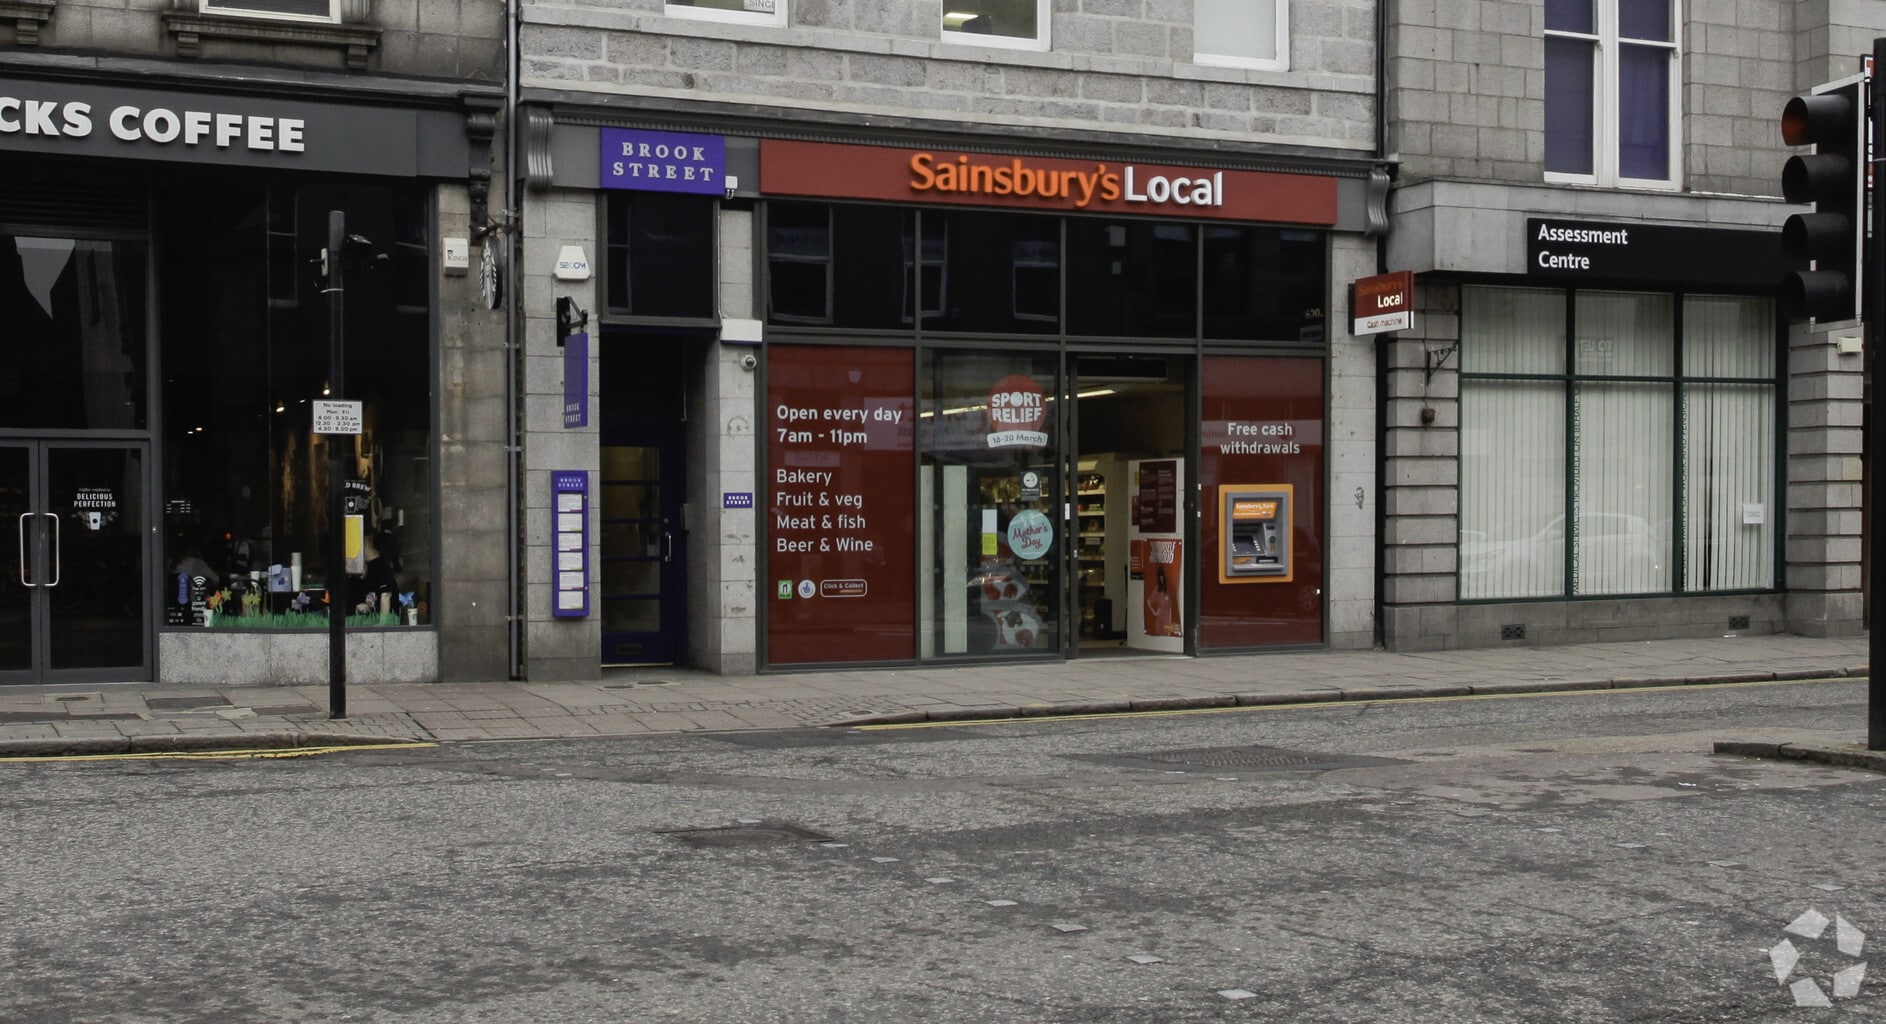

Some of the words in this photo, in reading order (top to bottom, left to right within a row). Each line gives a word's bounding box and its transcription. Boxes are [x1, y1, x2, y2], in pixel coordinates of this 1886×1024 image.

[0, 96, 93, 137] CKS
[109, 105, 305, 152] COFFEE
[622, 141, 705, 161] BROOK
[612, 161, 714, 182] STREET
[910, 152, 1121, 208] Sainsbury's
[1124, 165, 1223, 207] Local
[1538, 223, 1629, 245] Assessment
[1538, 250, 1590, 269] Centre
[1377, 291, 1404, 309] Local
[1367, 320, 1379, 329] Cash
[991, 391, 1042, 408] SPORT
[776, 405, 818, 423] Open
[823, 408, 869, 424] every
[873, 406, 902, 425] day
[992, 407, 1042, 424] RELIEF
[777, 428, 813, 443] 7am
[830, 429, 868, 446] 11pm
[1016, 433, 1042, 442] March
[1227, 422, 1258, 436] Free
[1261, 422, 1293, 436] cash
[1220, 441, 1301, 454] withdrawals
[776, 468, 832, 487] Bakery
[352, 482, 372, 492] BREW
[73, 500, 117, 508] PERFECTION
[776, 491, 814, 506] Fruit
[818, 492, 830, 506] &
[835, 494, 863, 510] veg
[776, 514, 816, 529] Meat
[821, 515, 833, 529] &
[837, 514, 866, 529] fish
[1012, 522, 1049, 540] Mother's
[776, 537, 814, 552] Beer
[819, 537, 831, 552] &
[835, 537, 874, 551] Wine
[1021, 536, 1043, 549] Day
